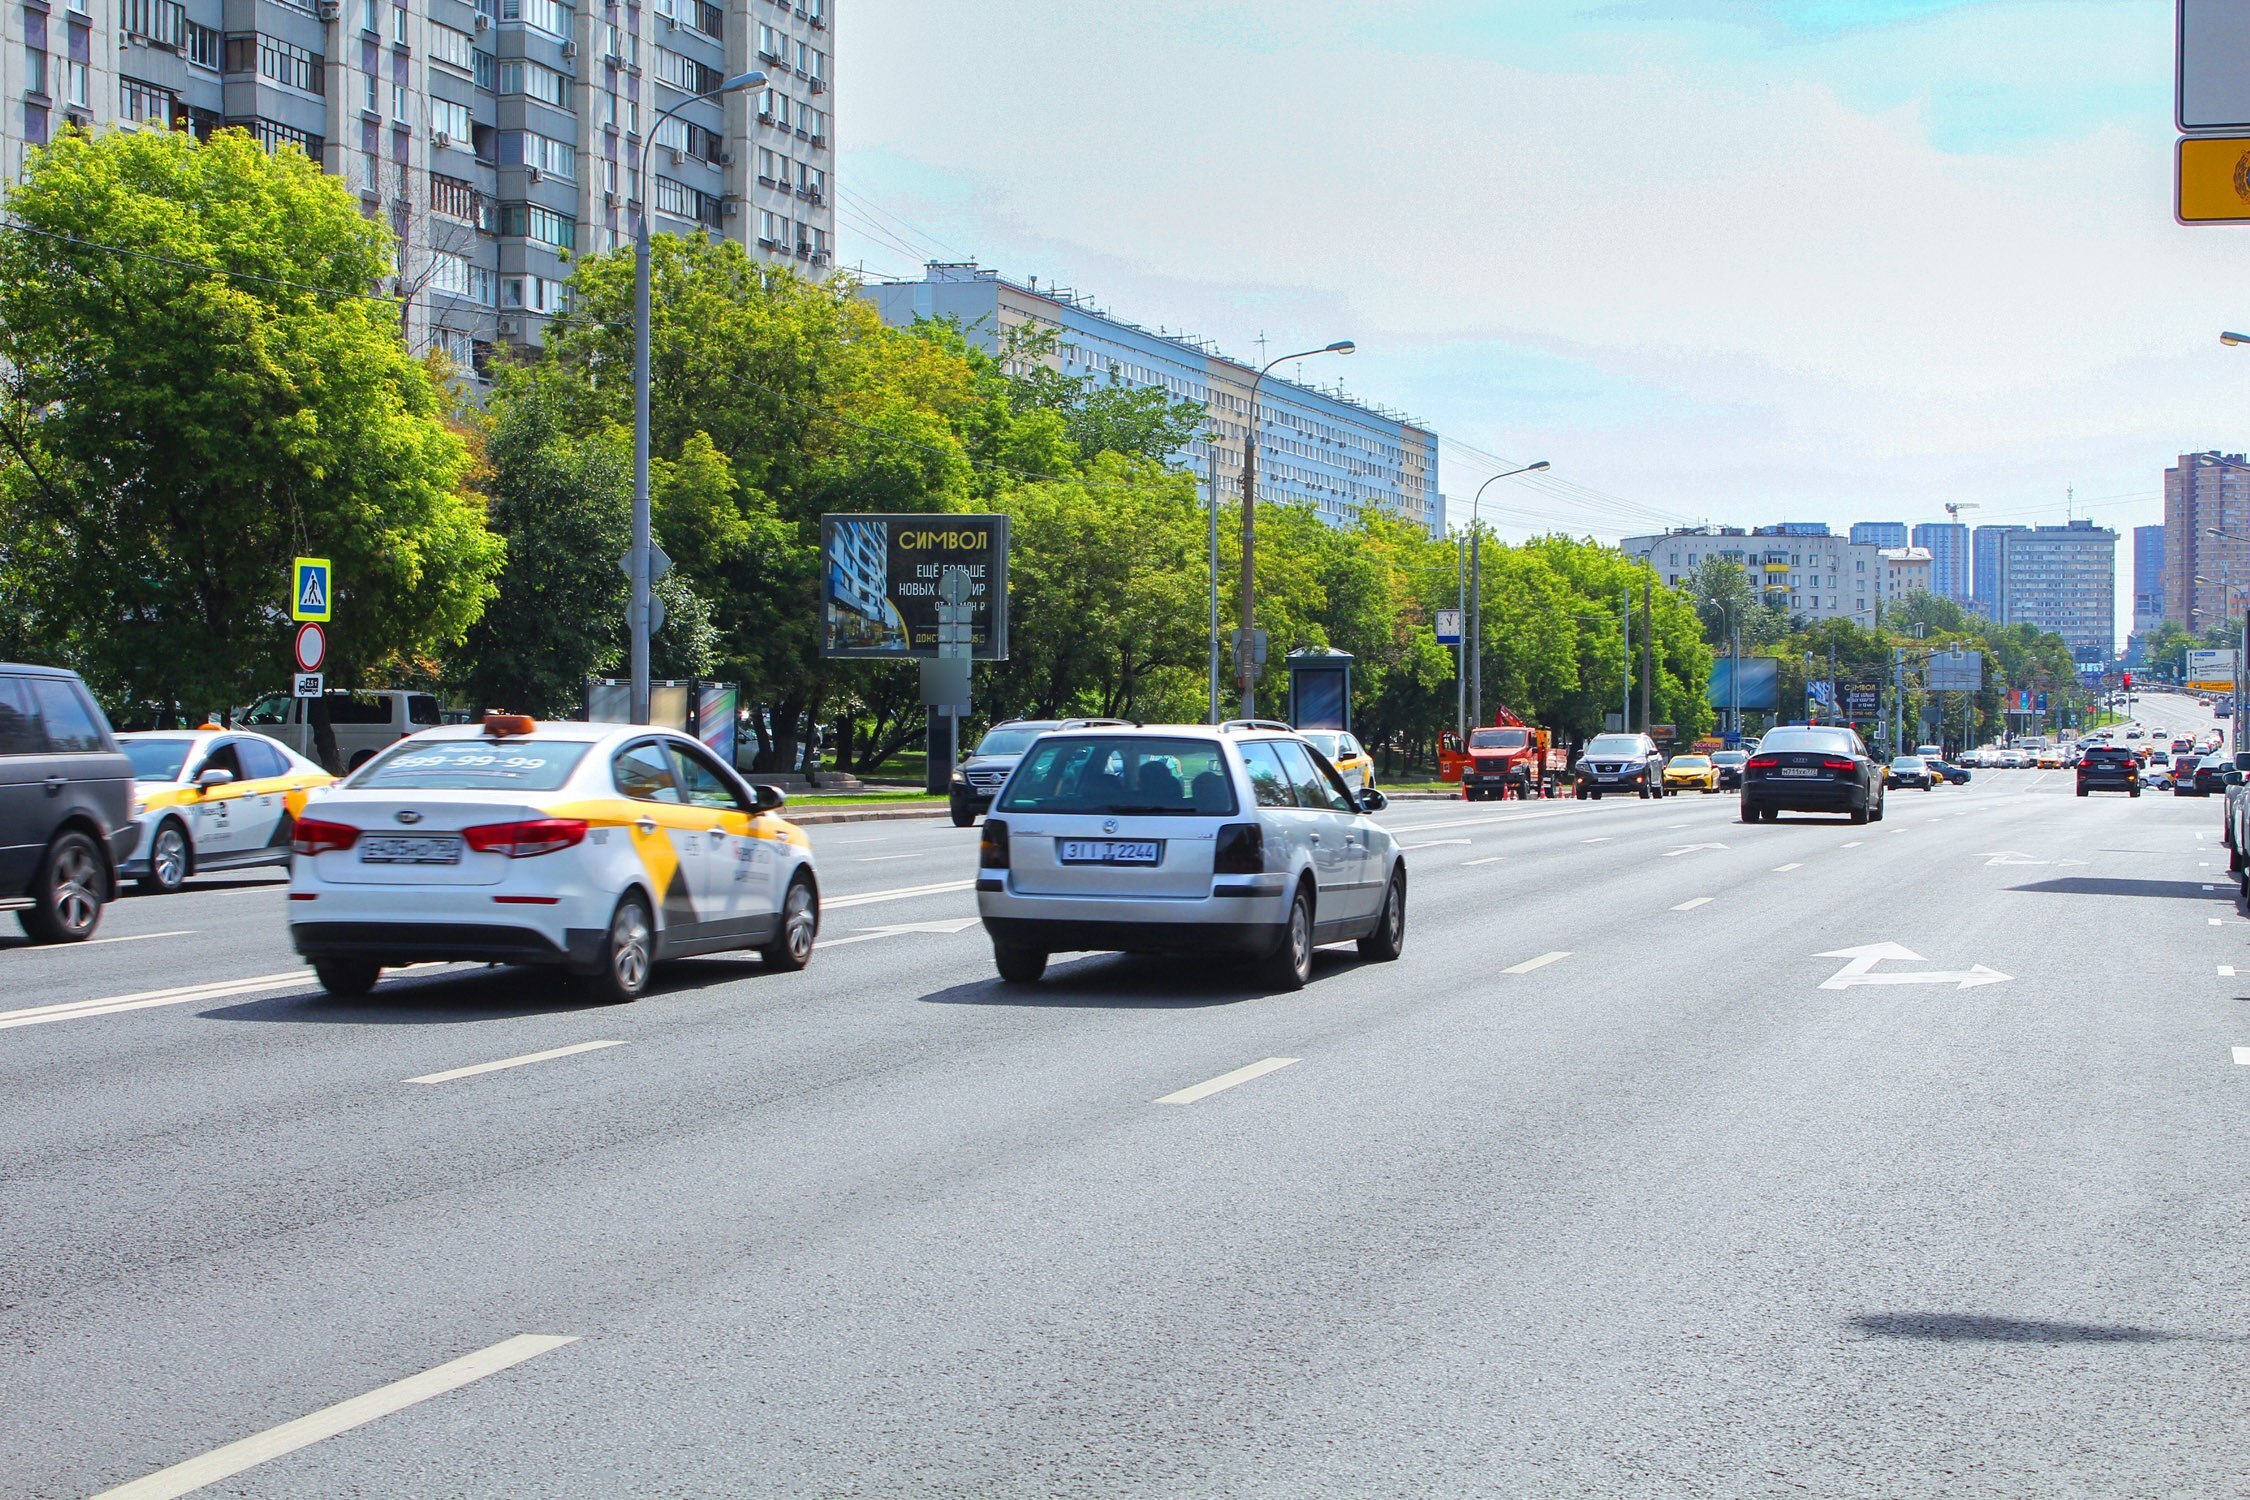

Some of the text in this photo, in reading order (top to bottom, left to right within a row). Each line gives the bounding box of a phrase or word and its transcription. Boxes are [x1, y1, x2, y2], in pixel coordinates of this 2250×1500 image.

[899, 531, 987, 549] СИМВОЛ
[916, 562, 939, 578] ЕЩЁ
[898, 582, 935, 596] НОВЫХ
[1118, 844, 1153, 858] 2244
